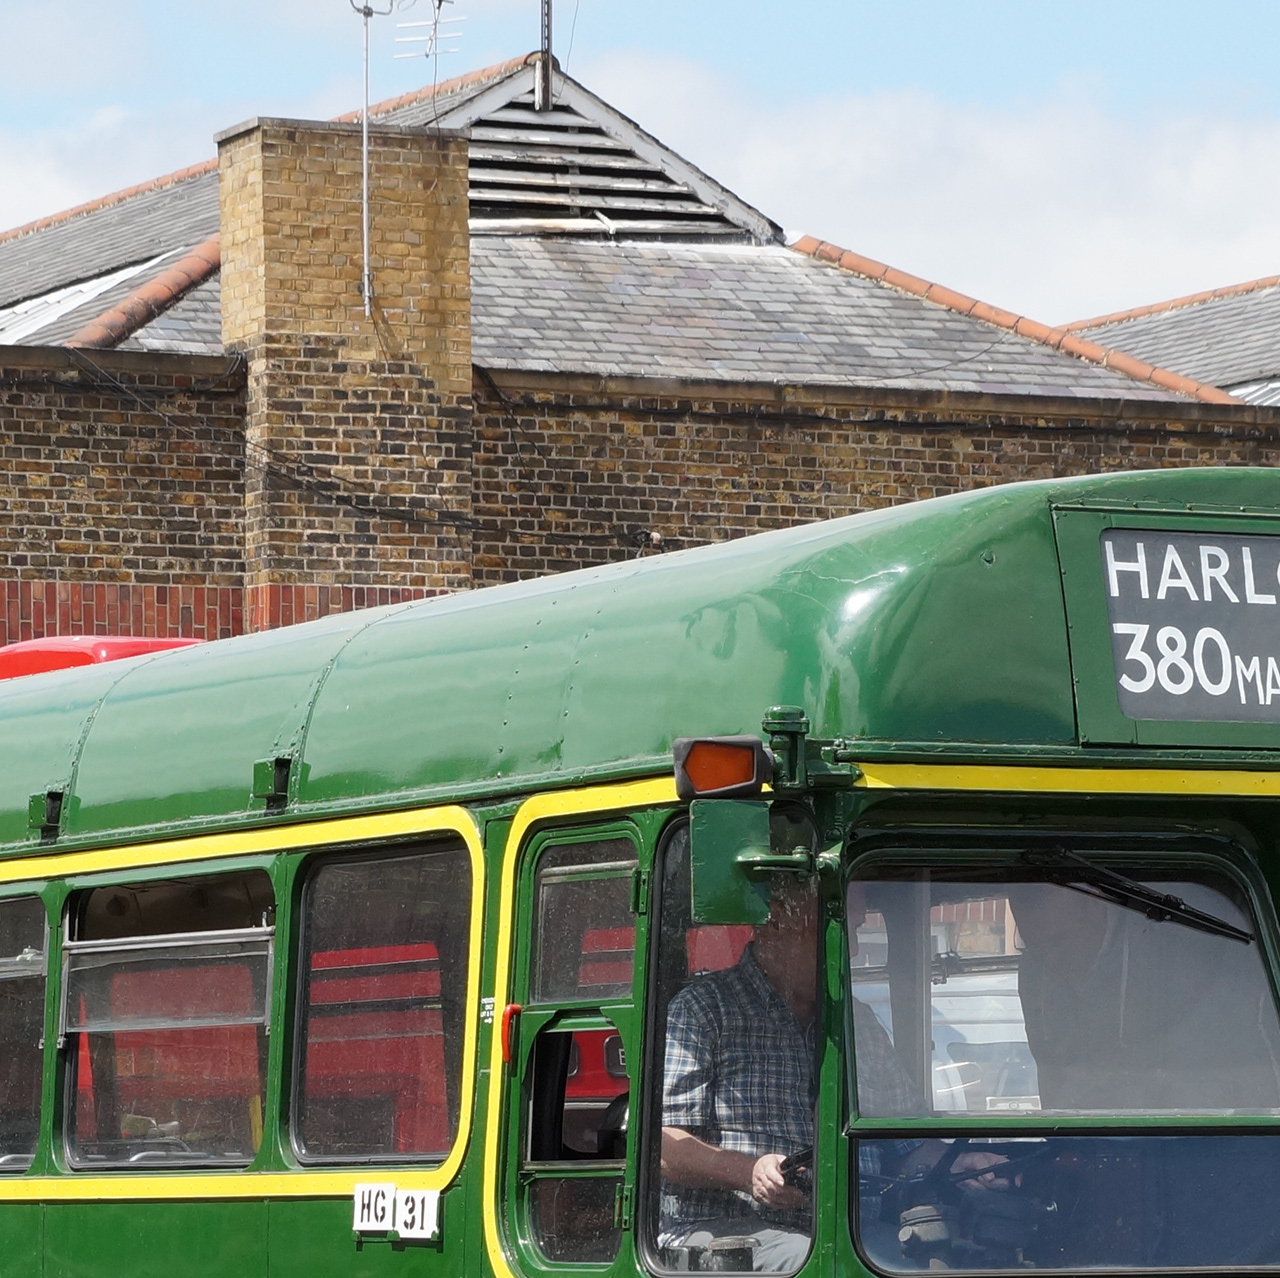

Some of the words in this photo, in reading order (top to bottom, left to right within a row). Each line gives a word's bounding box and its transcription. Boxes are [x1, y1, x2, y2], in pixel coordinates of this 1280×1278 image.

[1112, 623, 1232, 696] 380
[360, 1189, 386, 1223] HG
[403, 1195, 426, 1230] 31
